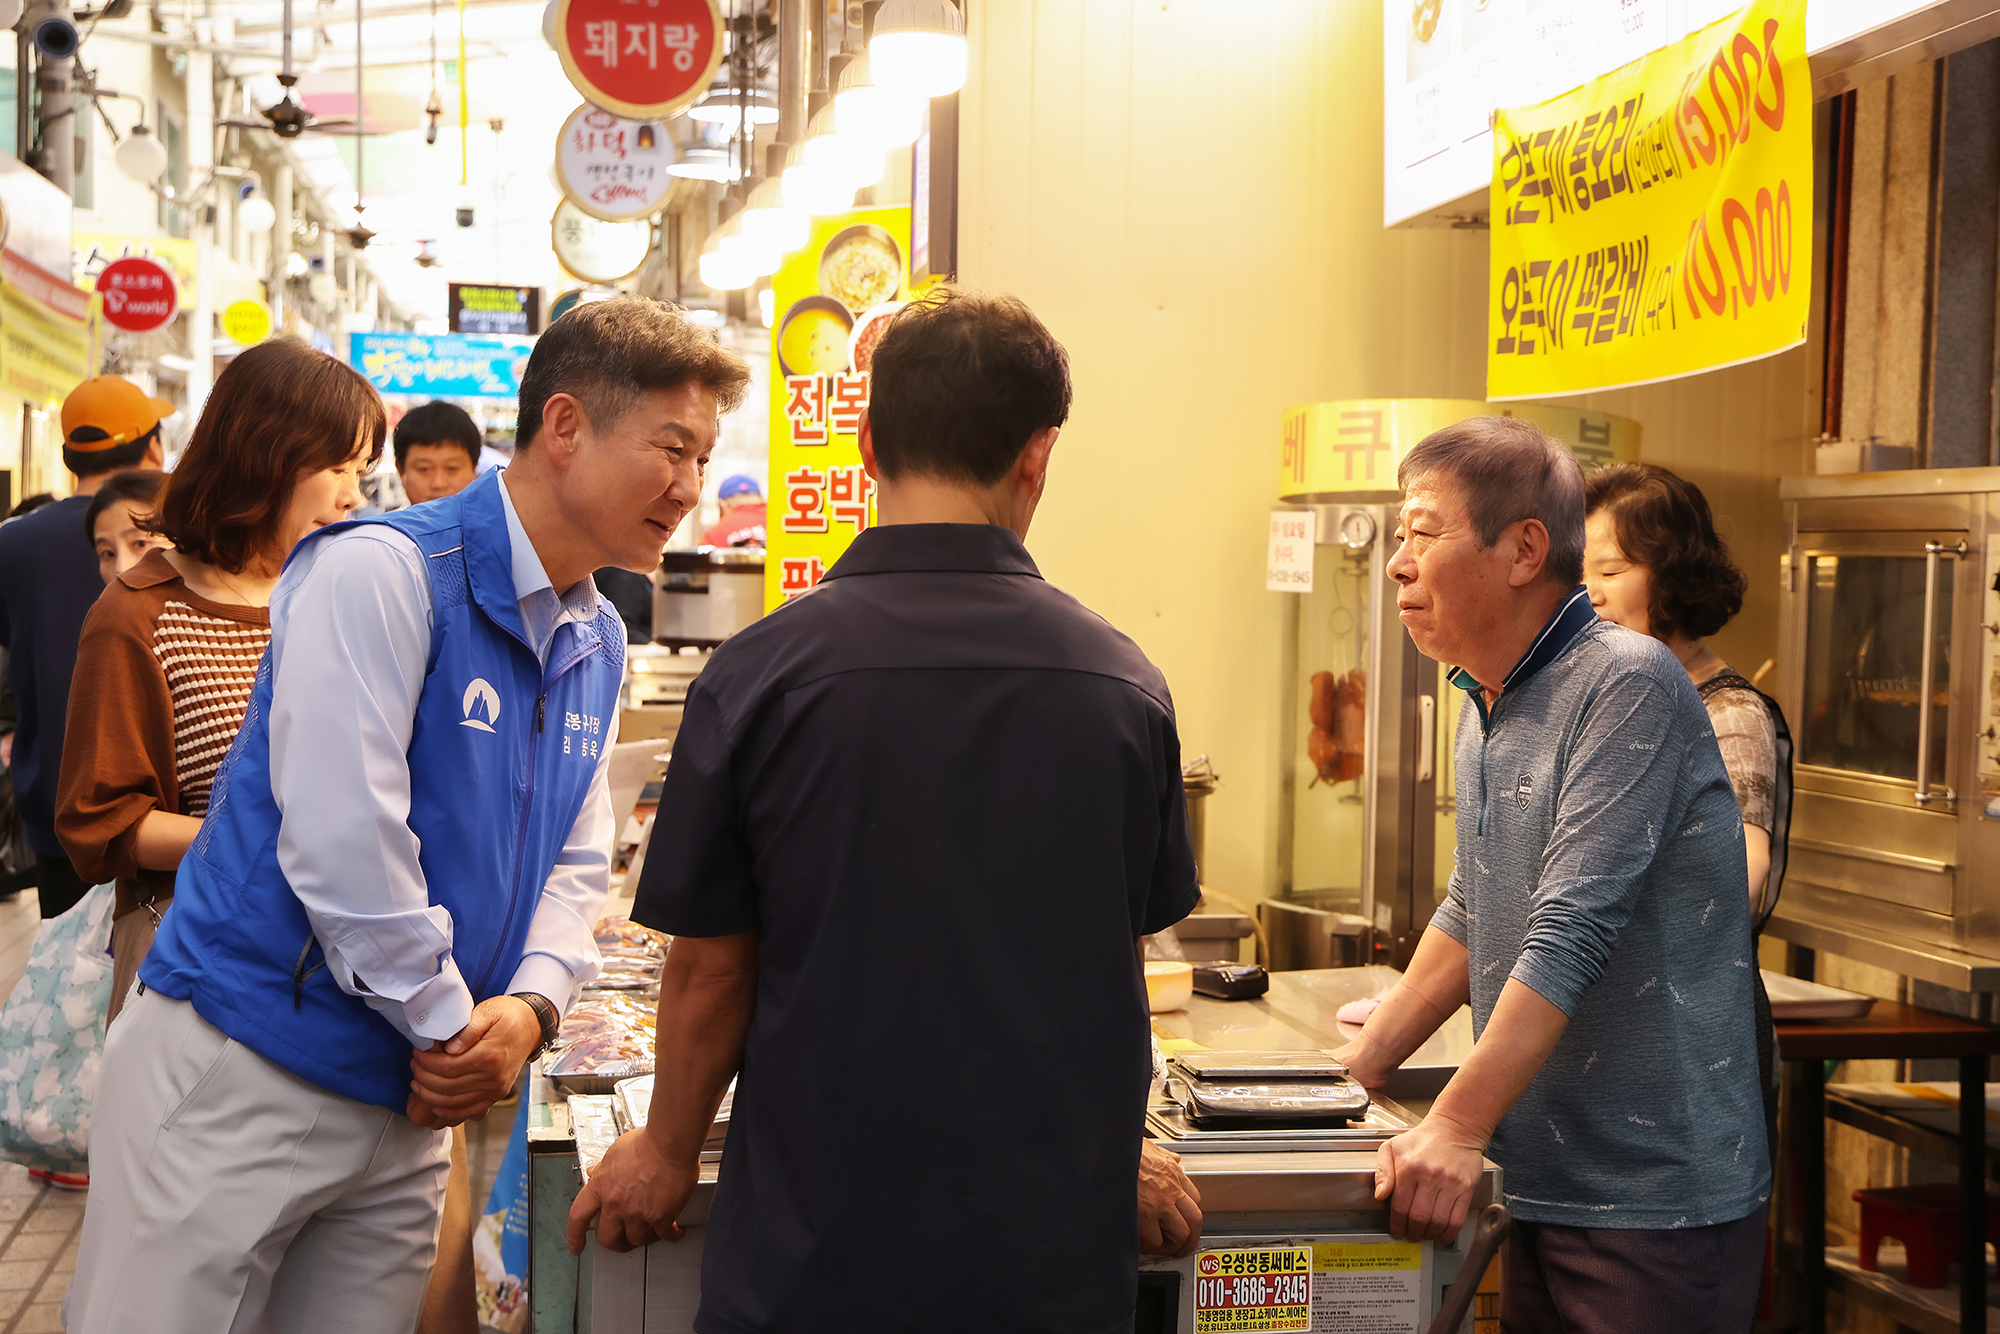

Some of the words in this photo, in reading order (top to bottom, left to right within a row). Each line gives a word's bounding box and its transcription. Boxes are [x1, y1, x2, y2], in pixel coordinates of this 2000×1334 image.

[584, 20, 701, 72] 돼지랑
[573, 129, 627, 161] 화덕
[585, 163, 656, 185] 생선구이
[1572, 235, 1649, 347] 떡갈비
[1682, 179, 1792, 321] 10,000
[126, 298, 169, 316] world
[1629, 739, 1655, 750] camp
[1682, 822, 1704, 836] camp
[1701, 898, 1715, 925] camp
[1636, 976, 1658, 998] camp
[1668, 981, 1685, 1005] camp
[1582, 1051, 1599, 1075] camp
[1708, 1057, 1732, 1072] camp
[1628, 1114, 1656, 1127] camp
[1548, 1120, 1565, 1145] camp
[1590, 1204, 1615, 1213] camp
[1200, 1259, 1219, 1271] WS
[1221, 1251, 1307, 1275] 우성냉동써비스
[1198, 1275, 1308, 1308] 010-3686-2345
[1197, 1309, 1233, 1323] 각종영업용
